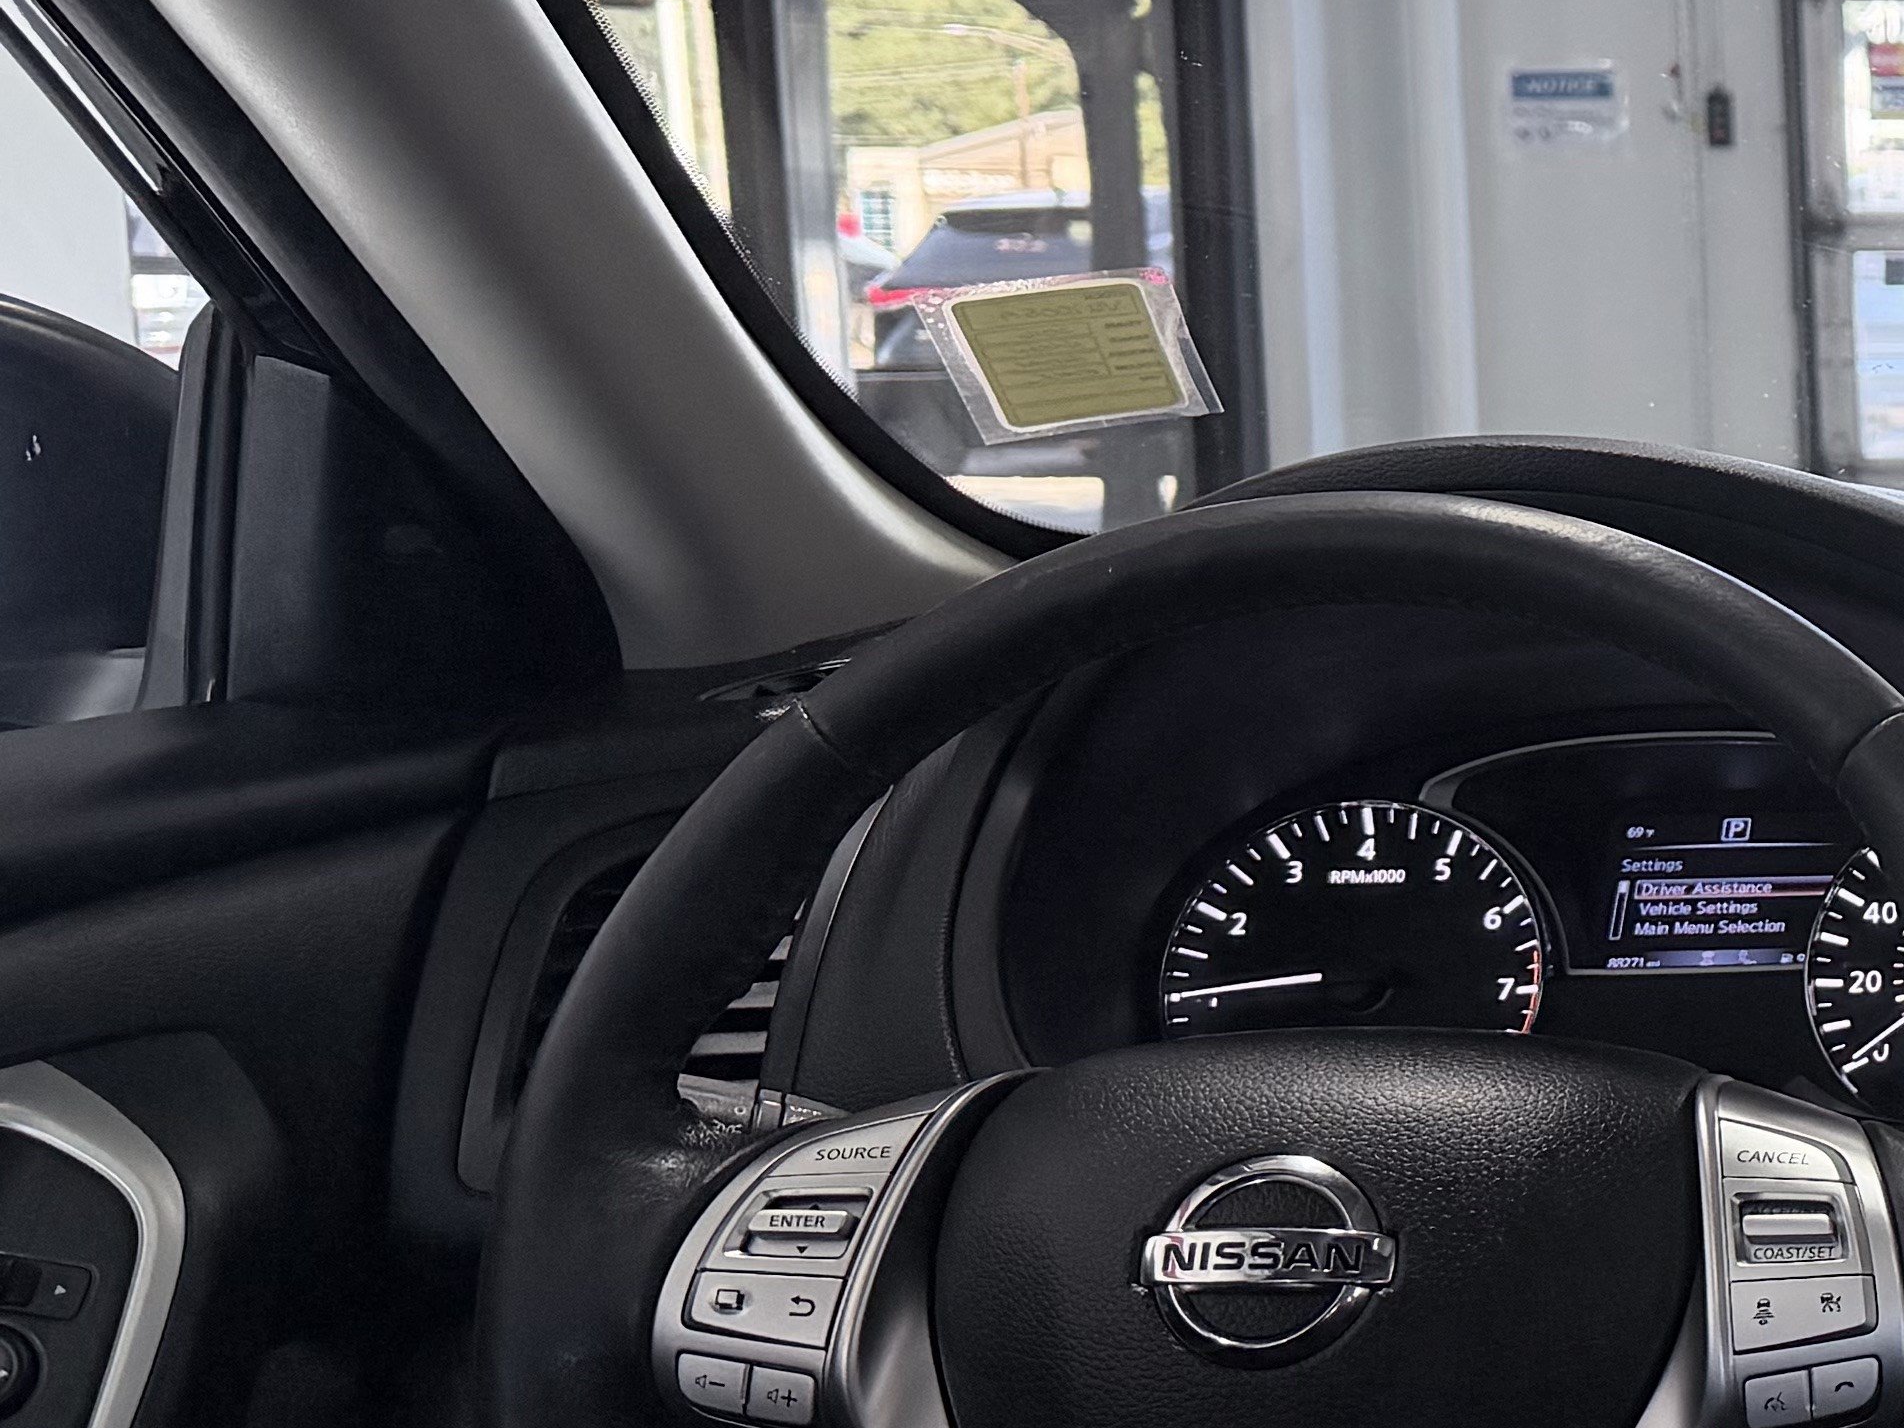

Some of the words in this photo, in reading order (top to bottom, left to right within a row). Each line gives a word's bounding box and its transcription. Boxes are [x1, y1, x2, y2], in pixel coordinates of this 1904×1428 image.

[1356, 837, 1377, 861] 4
[1284, 860, 1304, 884] 3
[1433, 858, 1452, 882] 5
[1620, 857, 1684, 874] Settings
[1640, 882, 1688, 896] Driver
[1692, 881, 1773, 895] Assistance
[1639, 901, 1692, 916] Vehicle
[1696, 900, 1759, 916] Settings
[1862, 901, 1899, 925] 40
[1228, 913, 1248, 937] 2
[1483, 910, 1503, 930] 6
[1634, 921, 1669, 936] Main
[1674, 921, 1715, 936] Menu
[1718, 919, 1786, 934] Selection
[1497, 977, 1516, 1001] 7
[1848, 969, 1883, 994] 20
[815, 1146, 892, 1161] SOURCE
[1736, 1149, 1810, 1166] CANCEL
[769, 1214, 826, 1228] ENTER
[1161, 1241, 1365, 1274] NISSAN
[1753, 1245, 1837, 1260] COAST/SET
